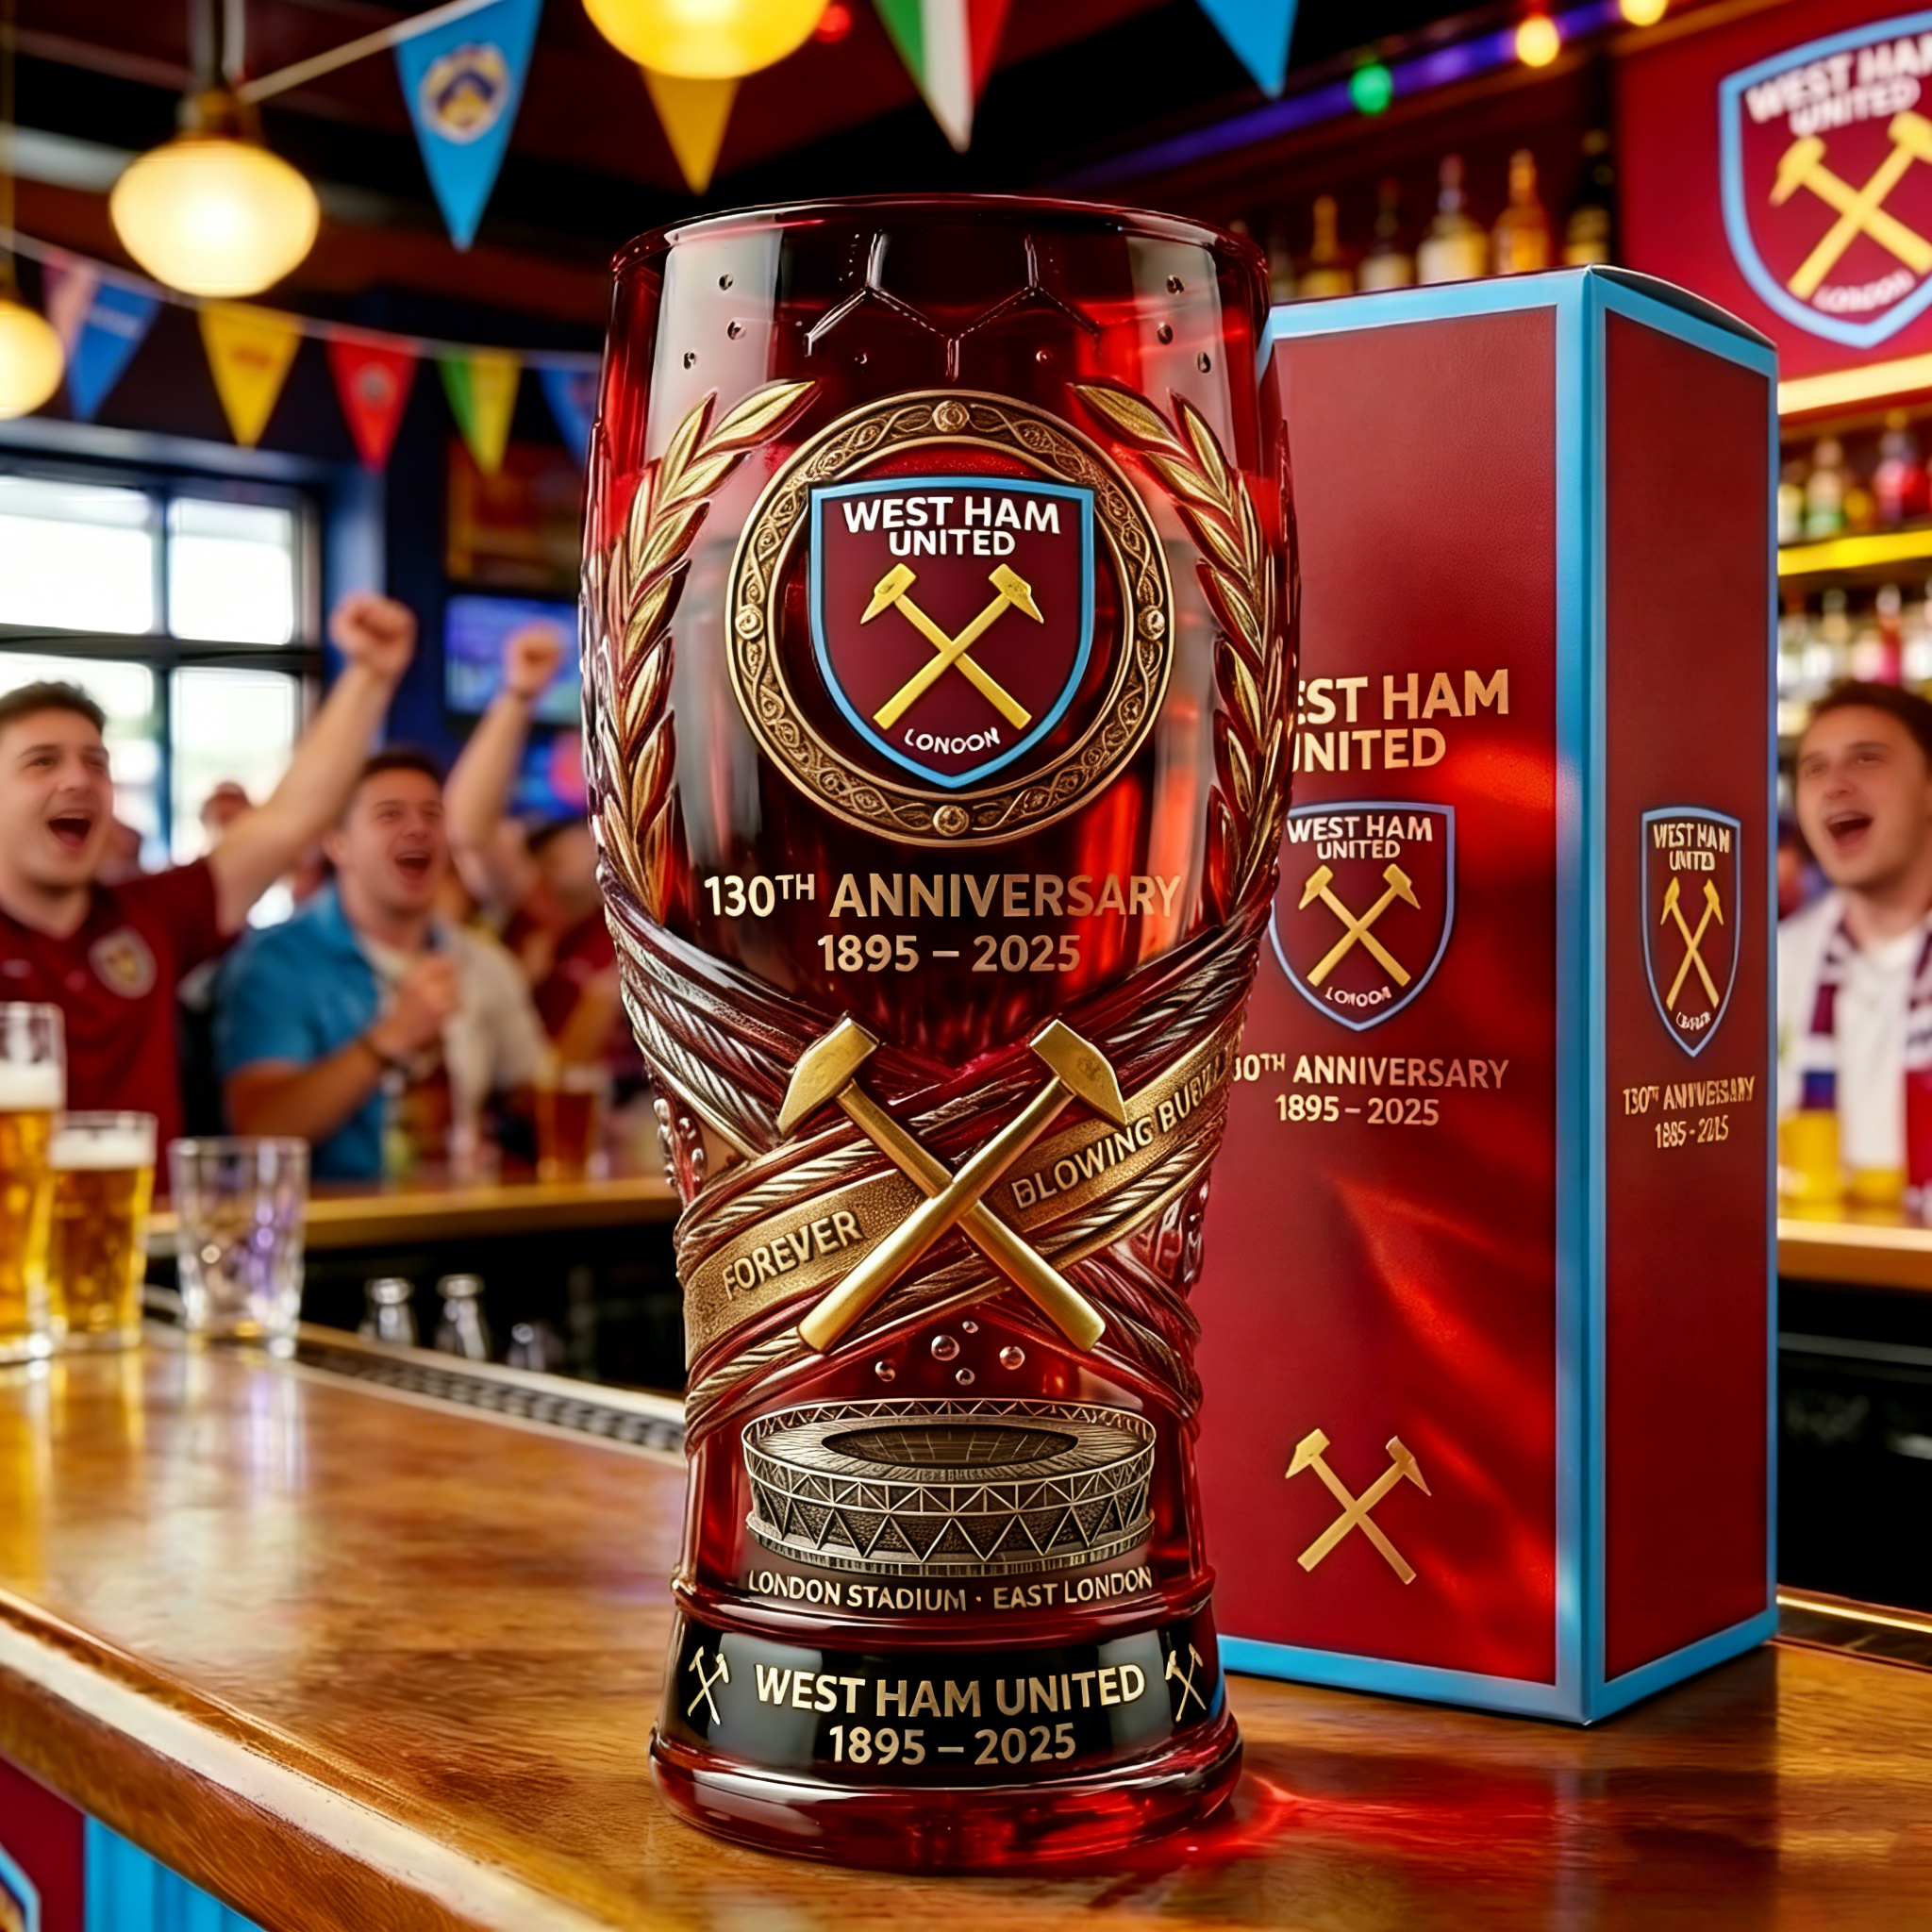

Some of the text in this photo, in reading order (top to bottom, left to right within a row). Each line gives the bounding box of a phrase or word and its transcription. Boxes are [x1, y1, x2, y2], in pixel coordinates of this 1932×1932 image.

[1745, 52, 1854, 124] WEST
[1790, 75, 1921, 136] UNITED
[842, 495, 1060, 534] WEST HAM
[890, 528, 1016, 556] UNITED
[1383, 668, 1509, 721] HAM
[1287, 815, 1433, 843] WEST HAM
[1317, 840, 1401, 859] UNITED
[704, 874, 1181, 917] 130TH ANNIVERSARY
[817, 934, 920, 973] 1895
[971, 934, 1081, 973] 2025
[1292, 1055, 1509, 1089] ANNIVERSARY
[1275, 1094, 1340, 1122] 1895
[1367, 1097, 1440, 1126] 2025
[723, 1210, 864, 1301] FOREVER
[1011, 1116, 1155, 1209] BLOWING
[748, 1570, 841, 1607] LONDON
[846, 1584, 967, 1612] STADIUM
[993, 1583, 1058, 1609] EAST
[1064, 1566, 1153, 1603] LONDON
[756, 1663, 1146, 1718] WEST HAM UNITED
[829, 1725, 926, 1765] 1895
[974, 1723, 1076, 1765] 2025
